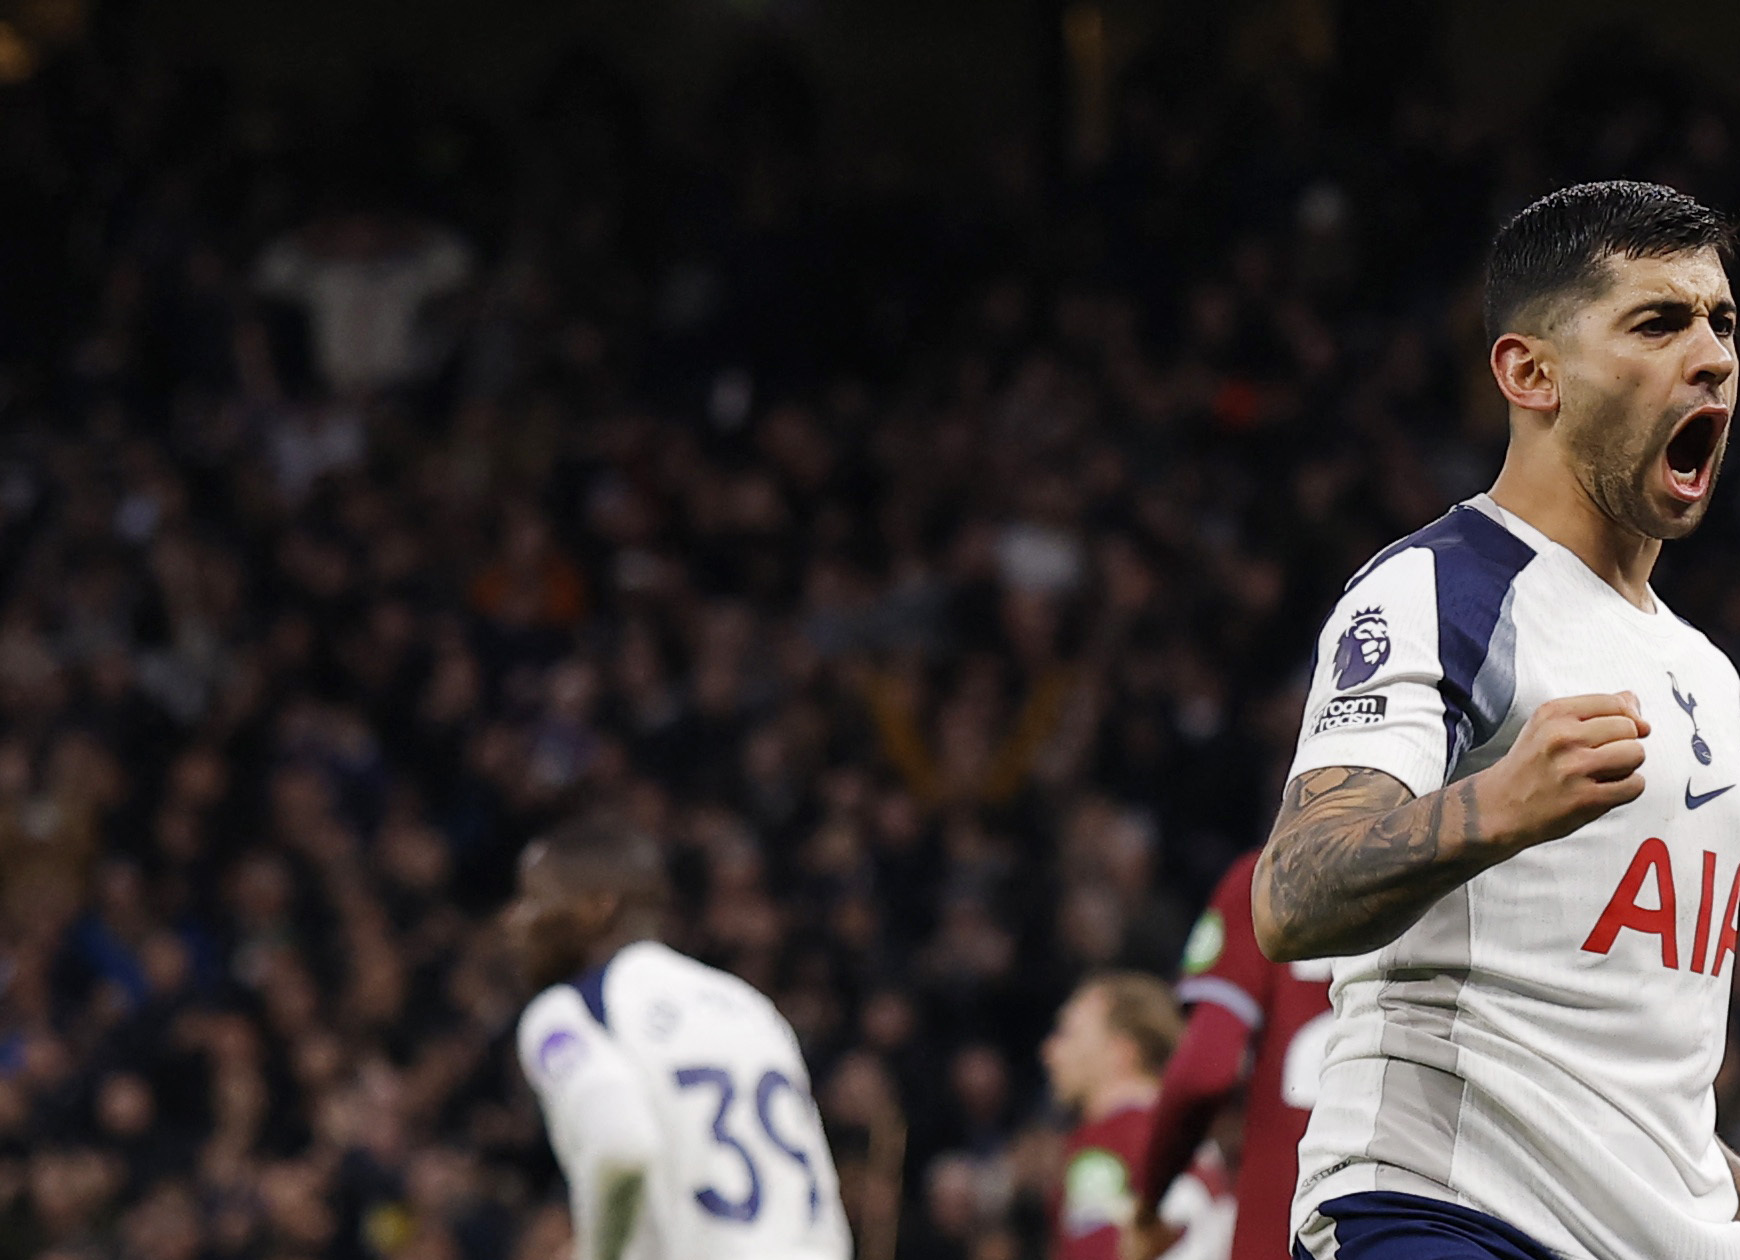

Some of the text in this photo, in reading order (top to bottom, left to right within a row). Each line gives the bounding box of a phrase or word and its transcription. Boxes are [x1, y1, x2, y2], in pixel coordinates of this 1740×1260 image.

[1323, 698, 1377, 717] room
[1319, 713, 1384, 732] racism
[675, 1069, 820, 1225] 39
